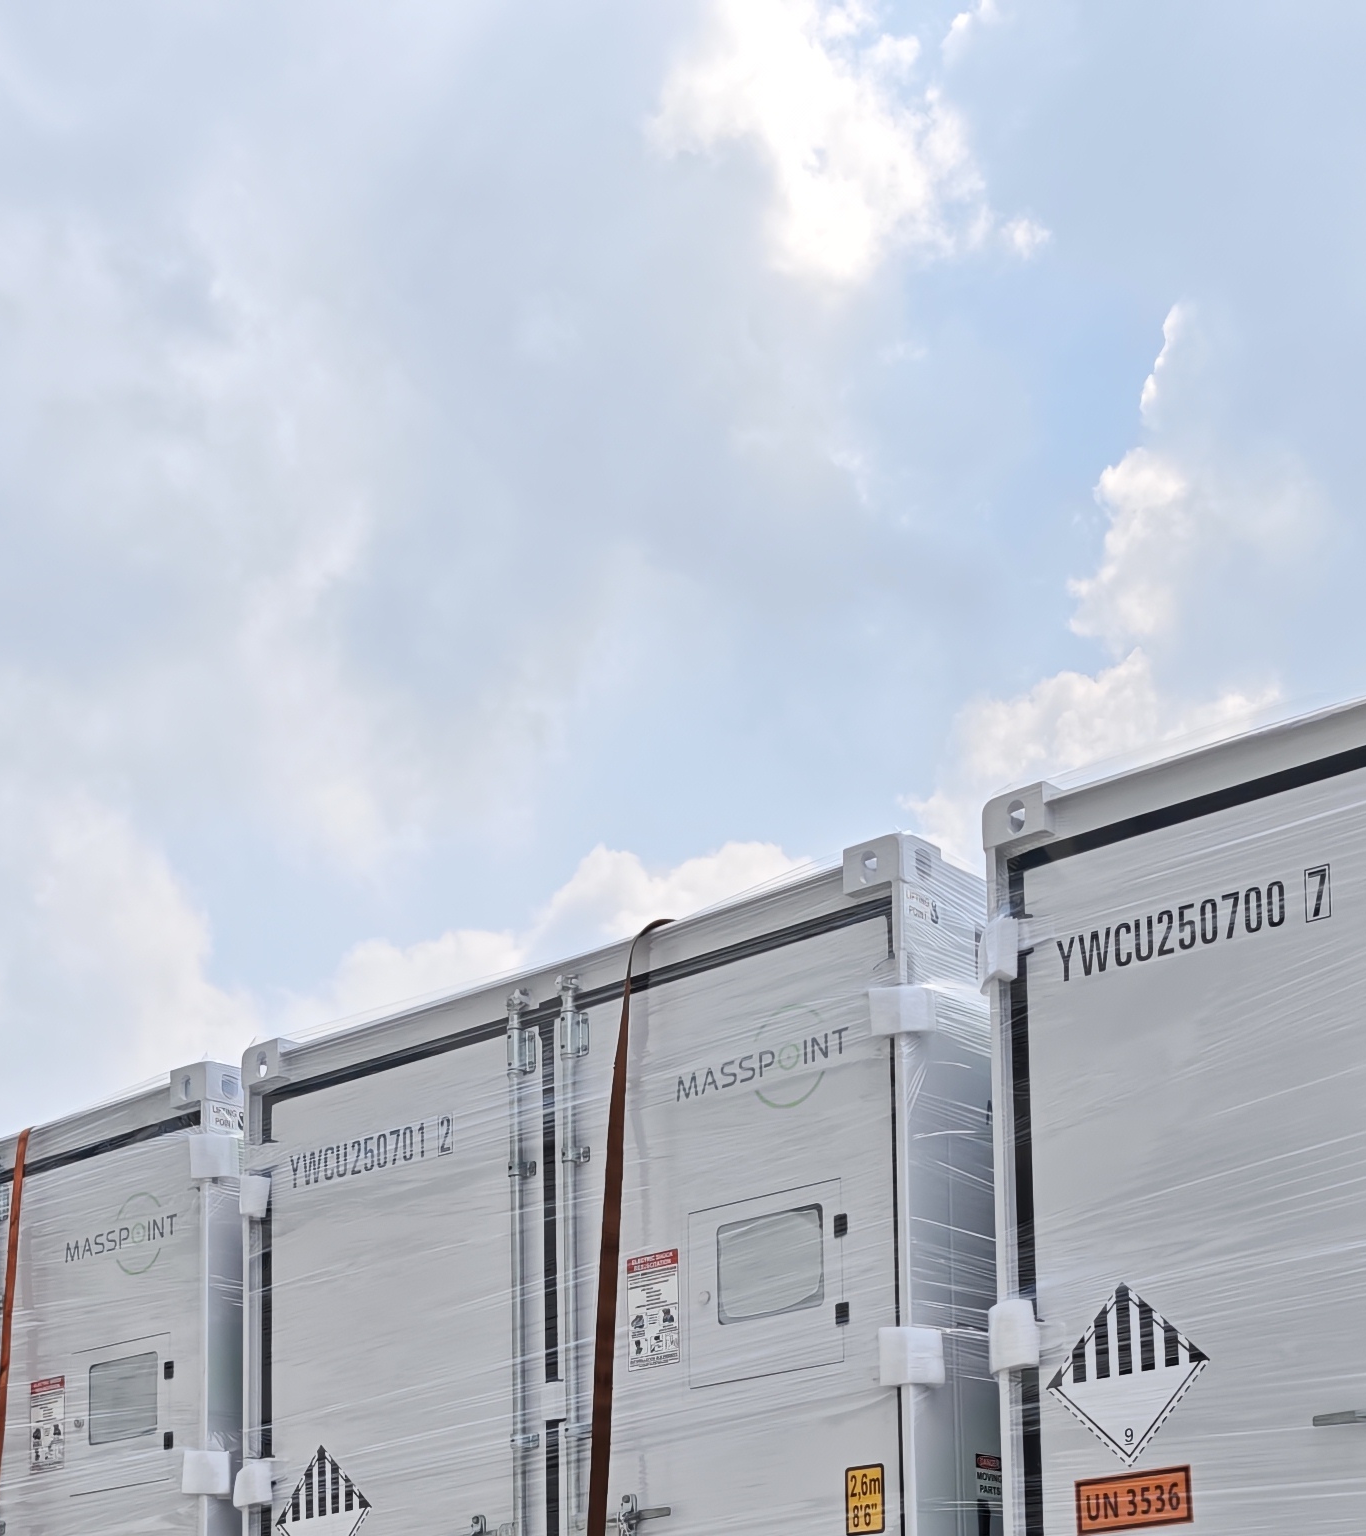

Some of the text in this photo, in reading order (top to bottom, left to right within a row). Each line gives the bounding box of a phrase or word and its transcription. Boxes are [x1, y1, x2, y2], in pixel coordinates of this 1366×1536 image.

[1056, 867, 1328, 982] YWCU250700 7
[676, 1026, 849, 1102] MASSPOINT
[289, 1116, 451, 1189] YWCU250701 2
[65, 1213, 177, 1263] MASSPOINT
[1124, 1427, 1134, 1443] 9
[850, 1473, 881, 1501] 2,6m
[979, 1485, 1002, 1495] PARTS
[1086, 1482, 1181, 1521] UN 3536
[852, 1503, 877, 1527] 8'6"
